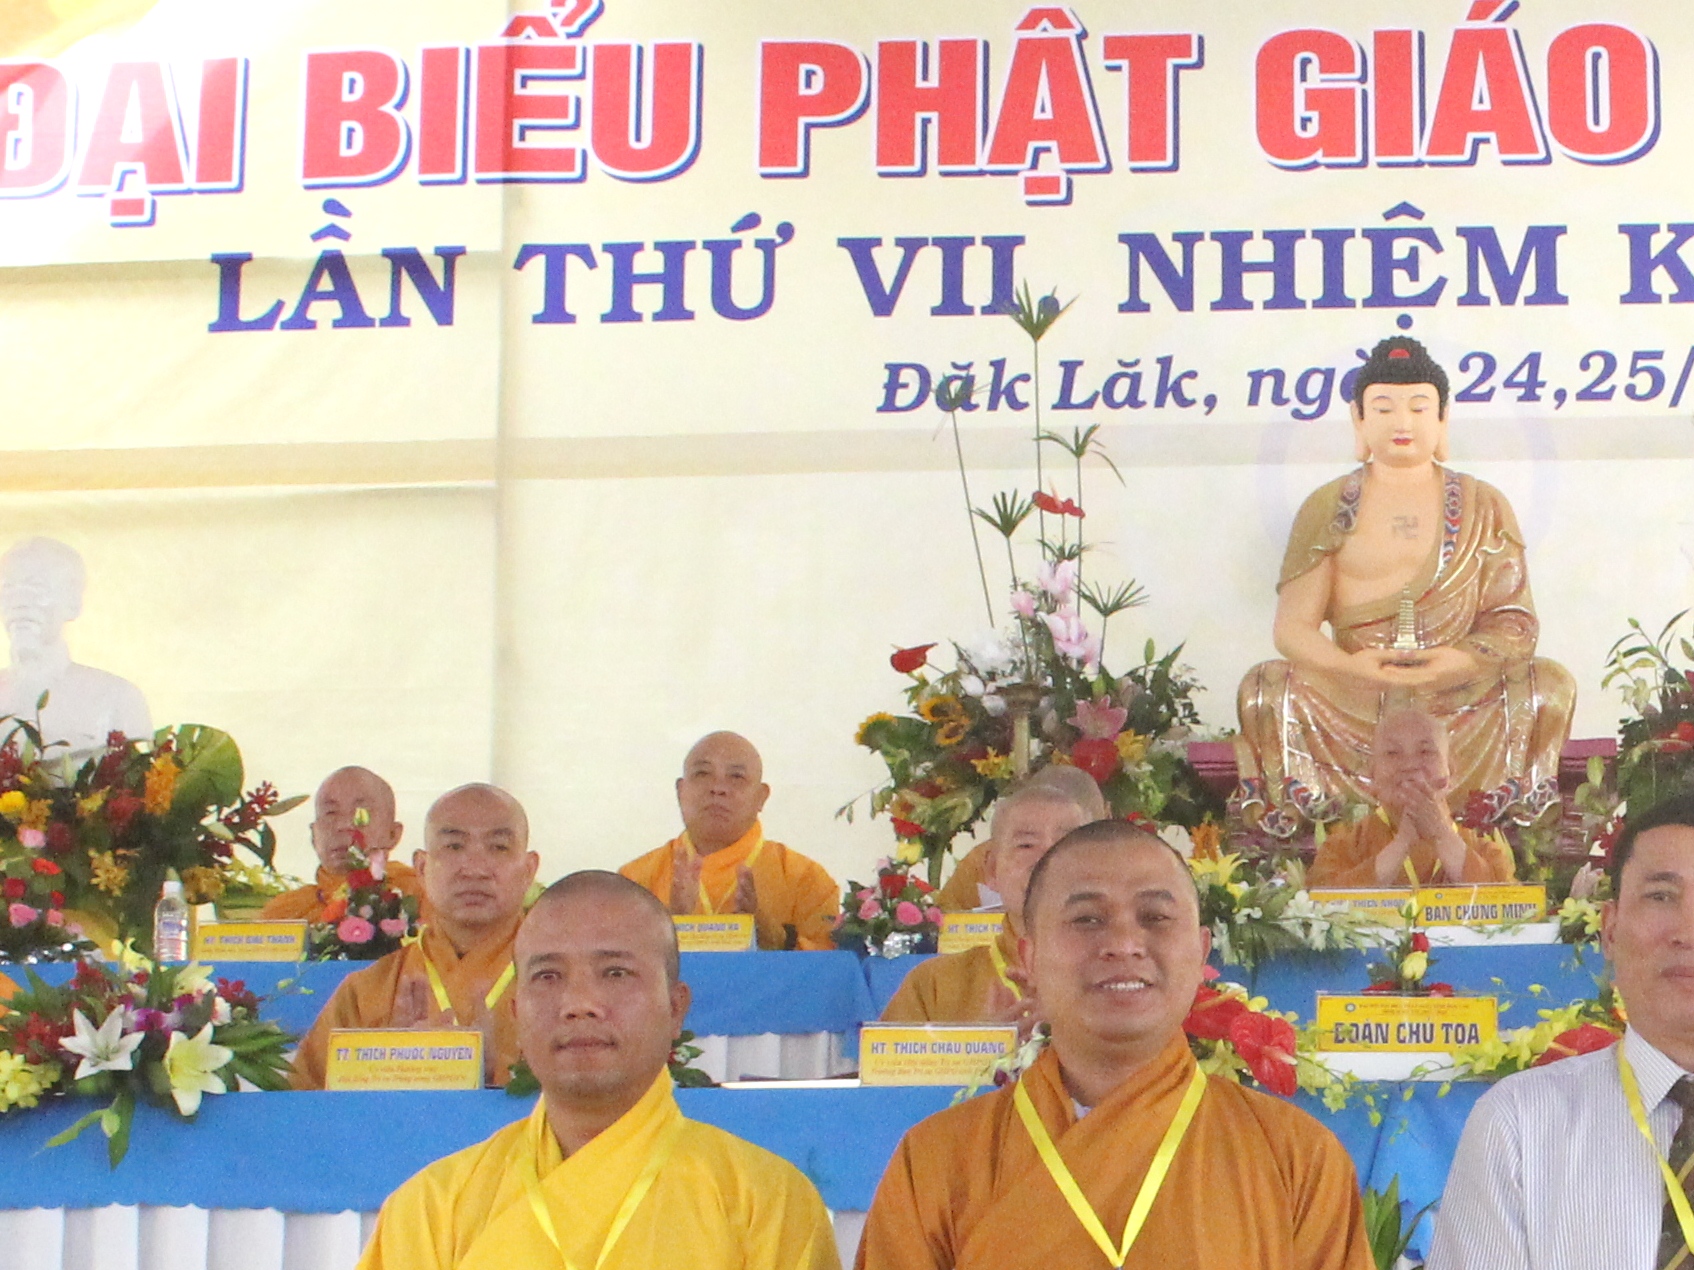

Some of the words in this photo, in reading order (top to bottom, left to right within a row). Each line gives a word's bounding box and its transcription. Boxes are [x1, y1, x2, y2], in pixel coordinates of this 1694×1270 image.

[757, 5, 1204, 208] PHẬT
[1254, 0, 1661, 171] GIÁO
[207, 198, 467, 334] LẦN
[512, 211, 796, 326] THỨ
[1116, 201, 1571, 330] NHIỆM
